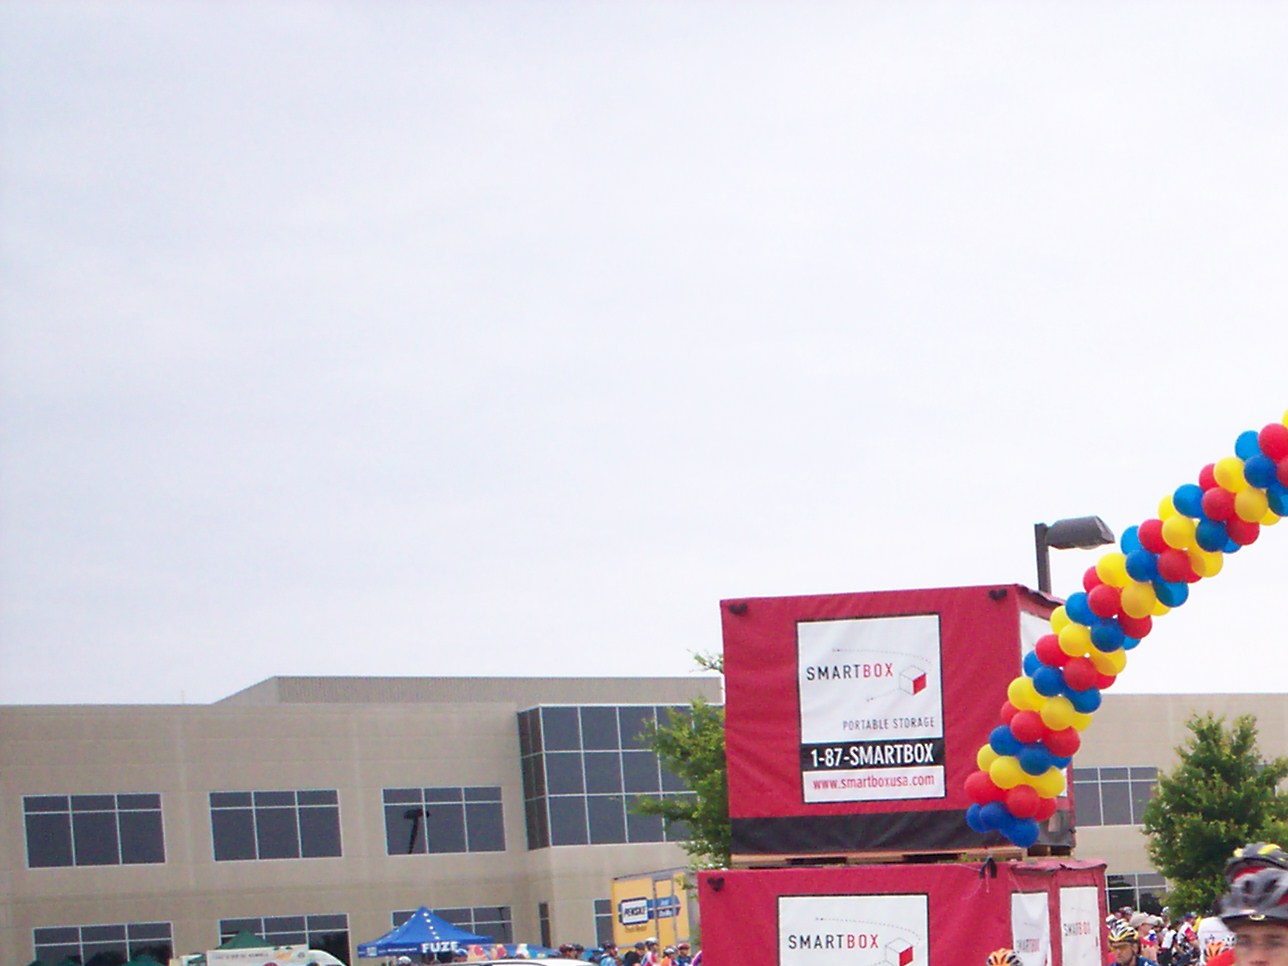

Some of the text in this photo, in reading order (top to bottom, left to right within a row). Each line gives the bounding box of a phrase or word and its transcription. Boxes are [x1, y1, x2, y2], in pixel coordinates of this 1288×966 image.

[806, 662, 894, 681] SMARTBOX
[843, 717, 934, 730] PORTABLE STORAGE
[810, 743, 934, 767] 1-87-SMARTBOX
[812, 774, 935, 789] www.smartboxusa.com
[788, 934, 879, 950] SMARTBOX
